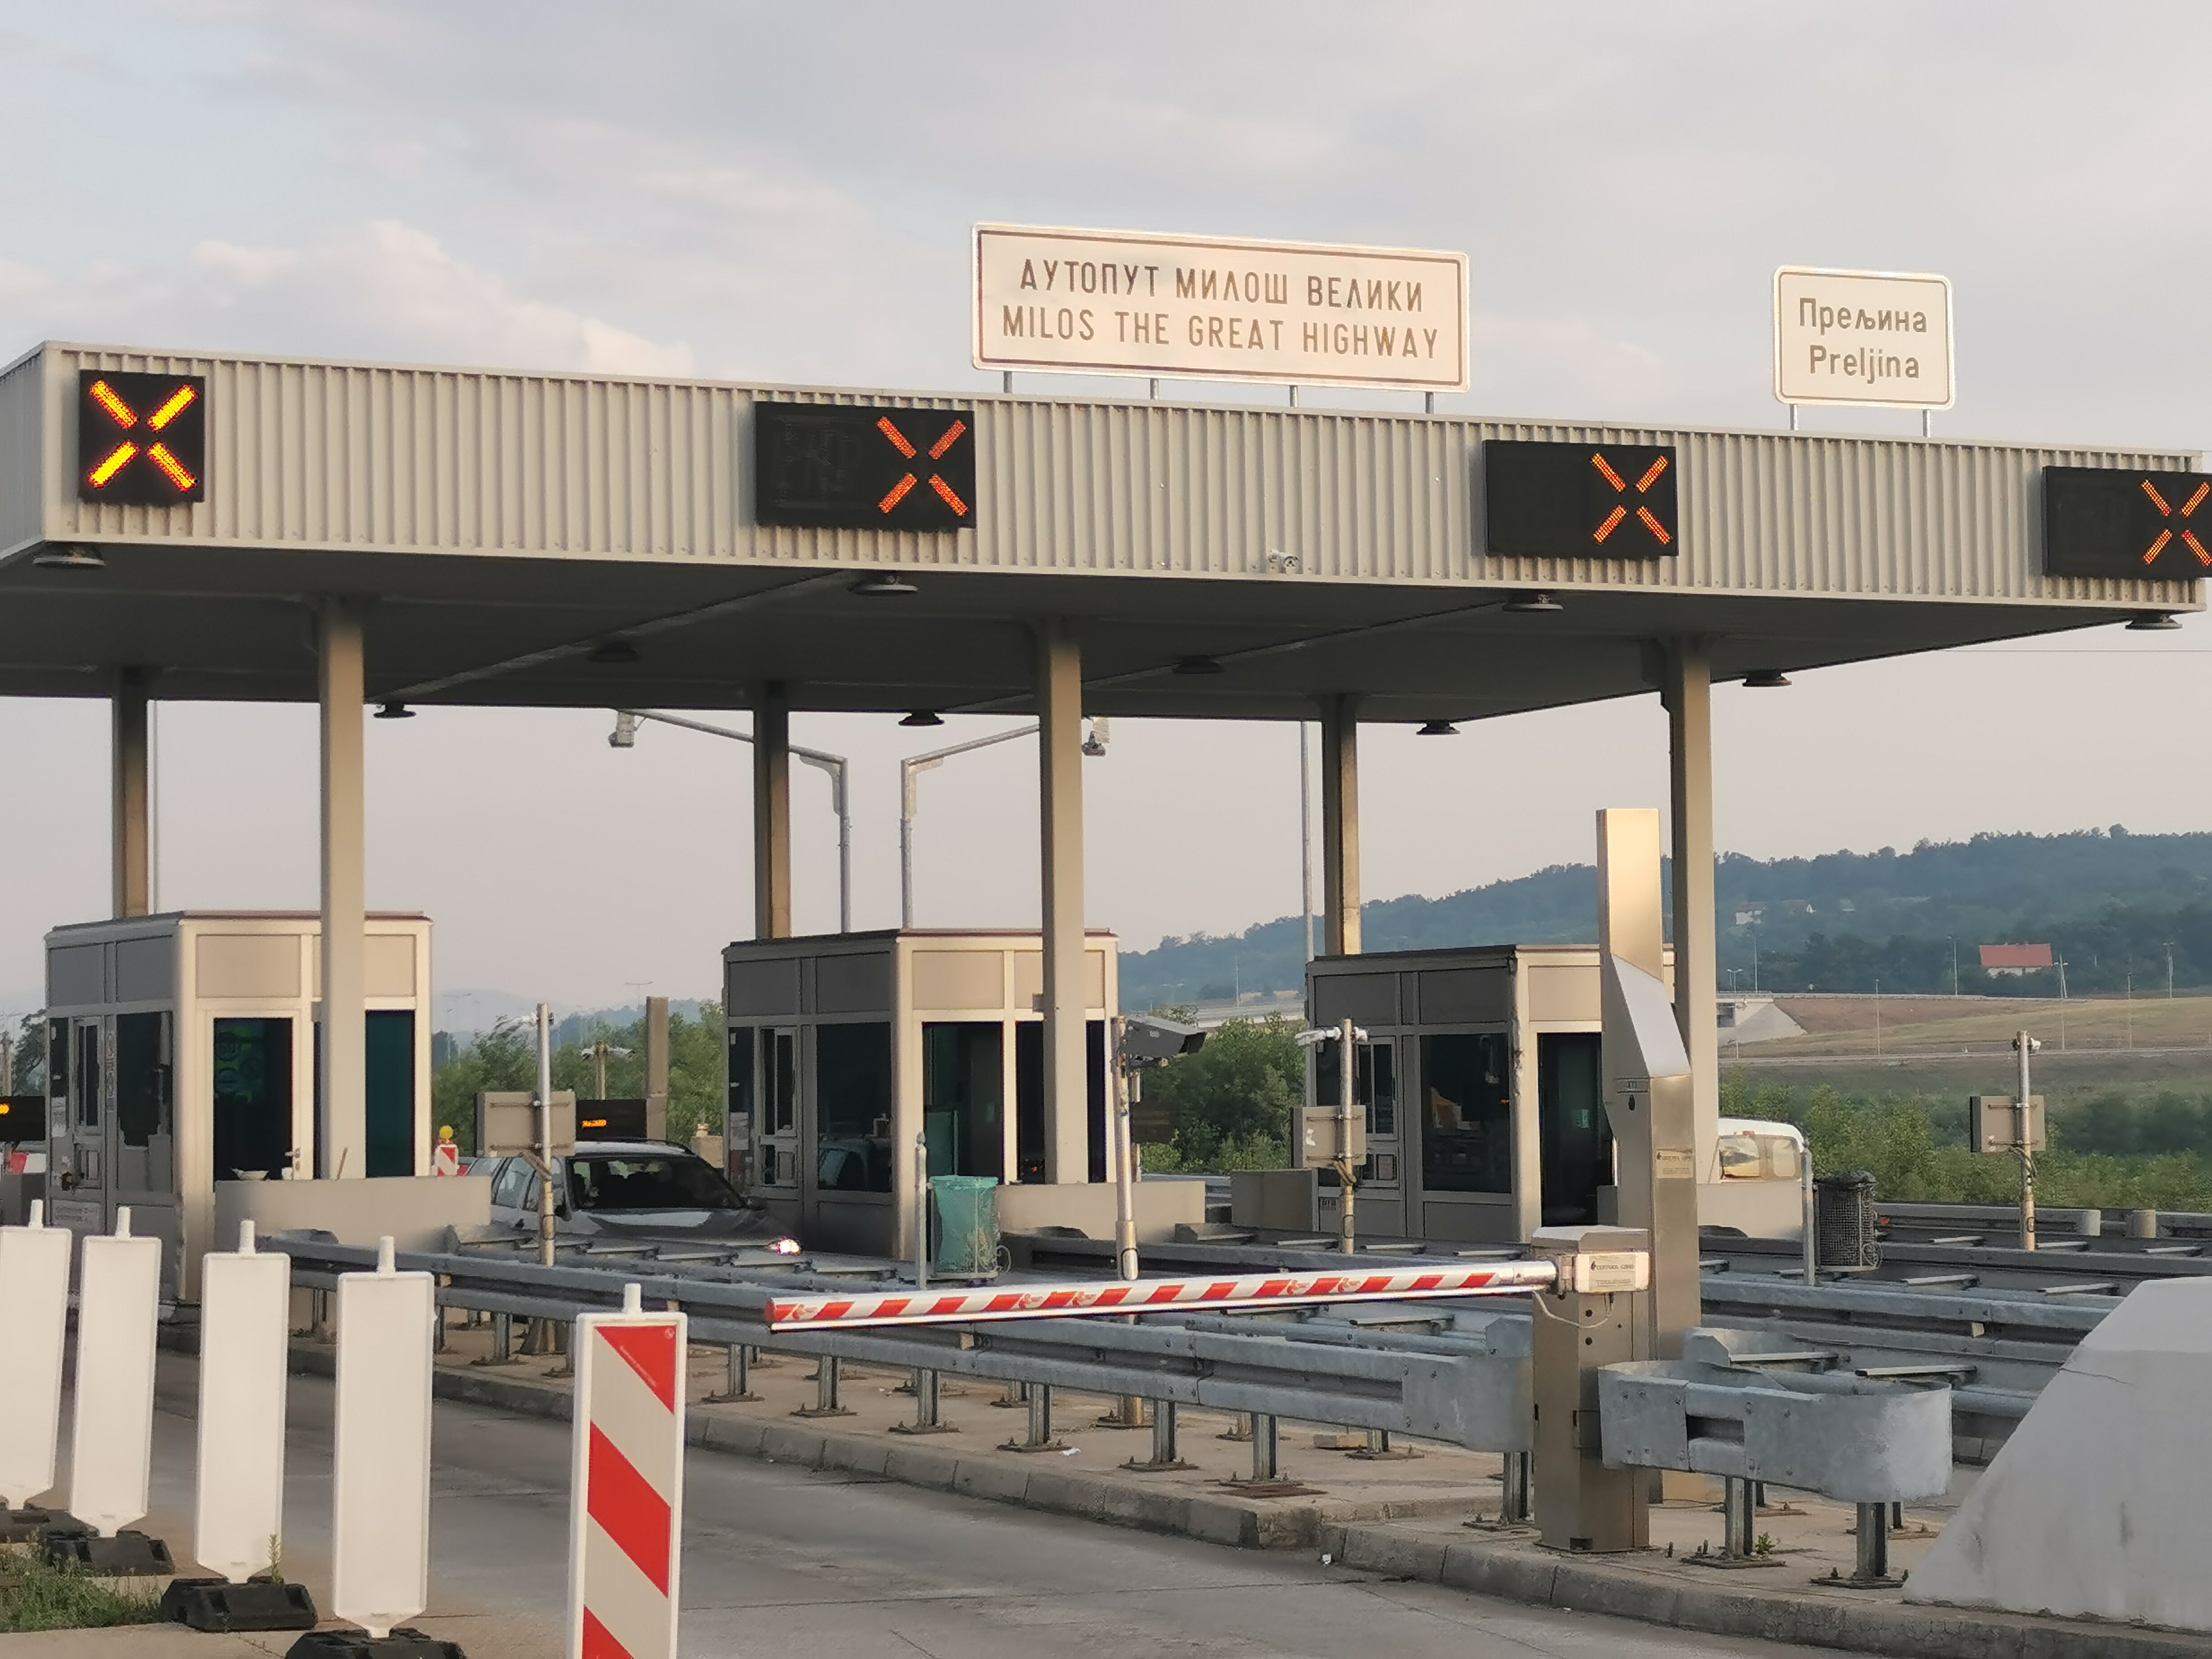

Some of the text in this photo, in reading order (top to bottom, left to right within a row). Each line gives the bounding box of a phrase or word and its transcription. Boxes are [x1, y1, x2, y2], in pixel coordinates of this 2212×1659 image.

[1020, 258, 1423, 312] АУТОПУТ МИЛОШ ВЕЛИКИ
[1003, 305, 1438, 359] MILOS THE GREAT HIGHWAY
[1799, 297, 1928, 335] Прељина
[1809, 344, 1920, 384] Preljina
